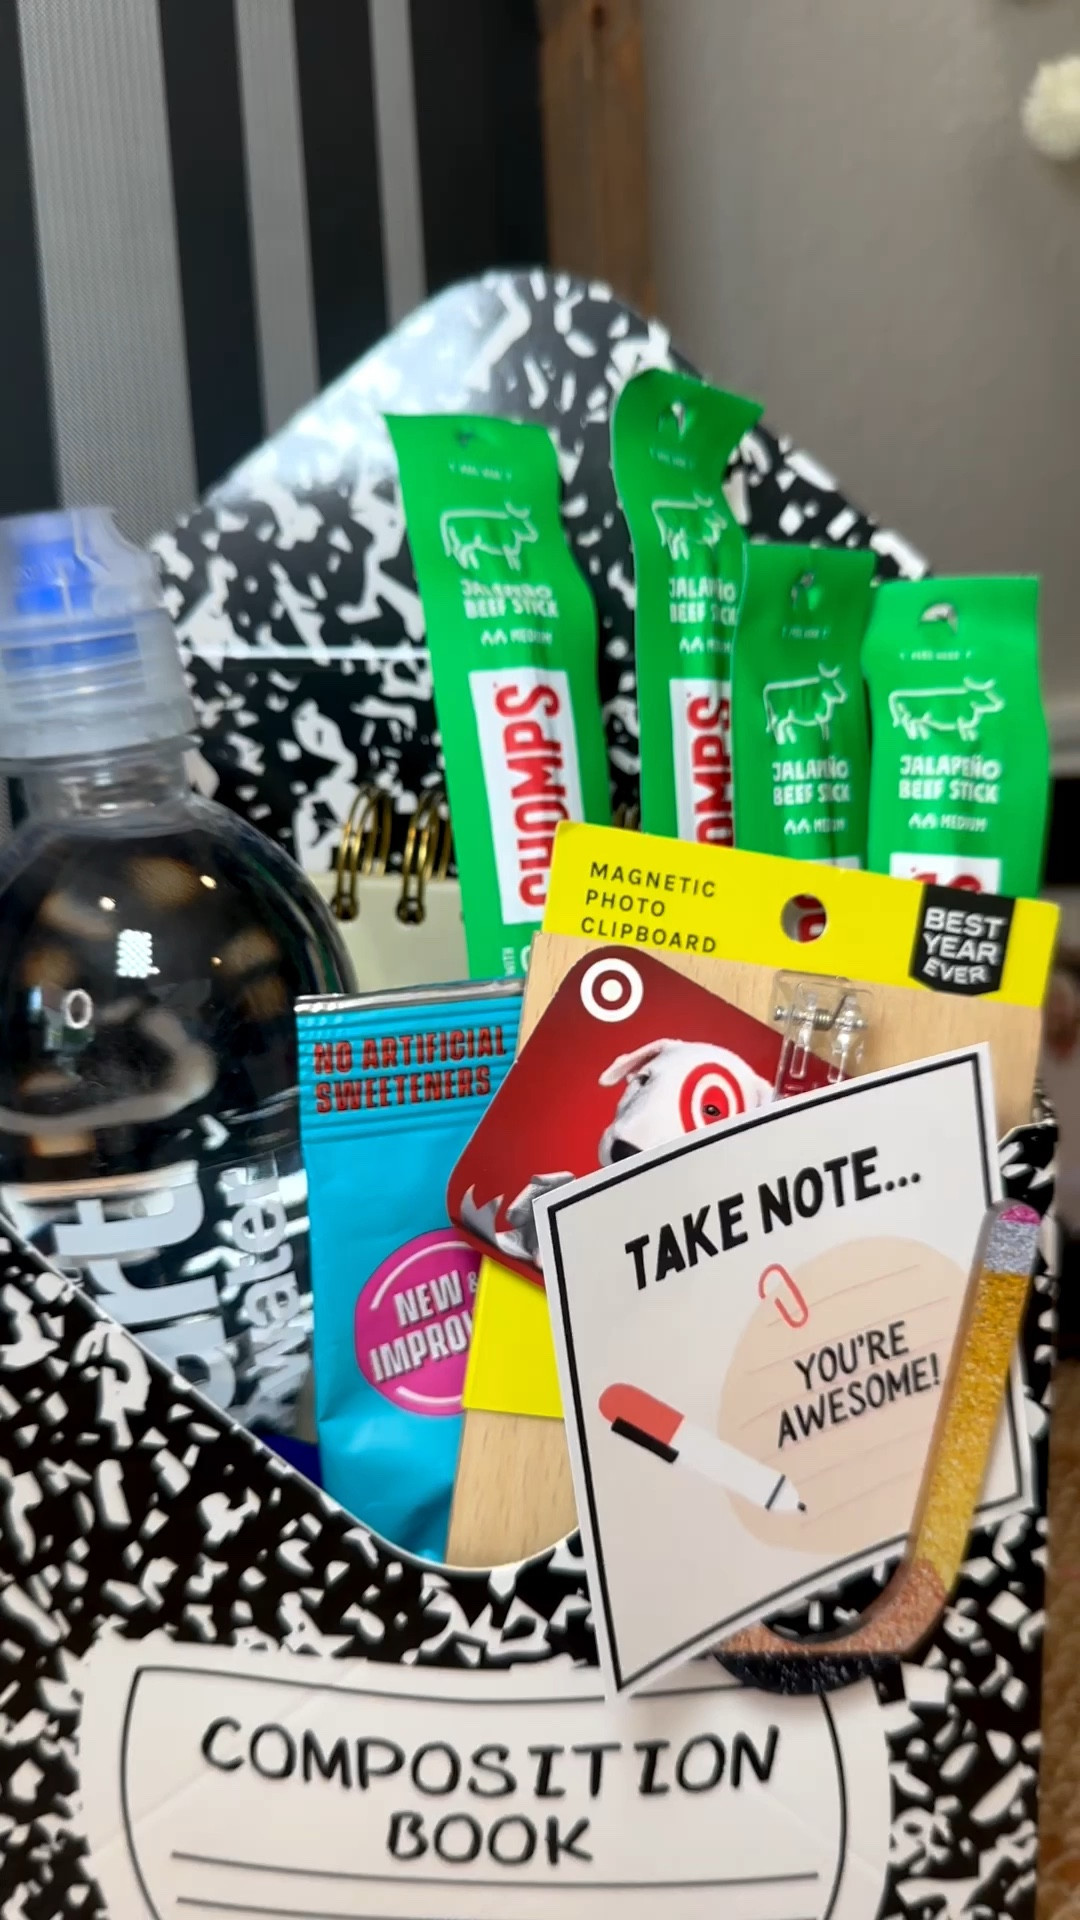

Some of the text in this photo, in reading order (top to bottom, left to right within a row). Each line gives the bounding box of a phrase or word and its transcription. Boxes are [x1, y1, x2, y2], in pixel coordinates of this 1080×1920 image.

[900, 755, 1001, 781] JALAPEÑO
[773, 783, 813, 806] BEEF
[899, 779, 999, 804] BEEF STICK
[941, 814, 987, 831] MEDIUM
[589, 861, 717, 898] MAGNETIC
[585, 889, 665, 917] PHOTO
[580, 917, 717, 953] CLIPBOARD
[923, 907, 1006, 939] BEST
[922, 932, 1001, 965] YEAR
[922, 957, 990, 985] EVER
[313, 1026, 507, 1074] NO ARTIFICIAL
[316, 1066, 490, 1113] SWEETENERS
[624, 1146, 921, 1291] TAKE NOTE...
[393, 1269, 464, 1328] NEW
[794, 1320, 910, 1390] YOU'RE
[778, 1353, 941, 1449] AWESOME!
[200, 1716, 780, 1799] COMPOSITION
[386, 1811, 594, 1867] BOOK
